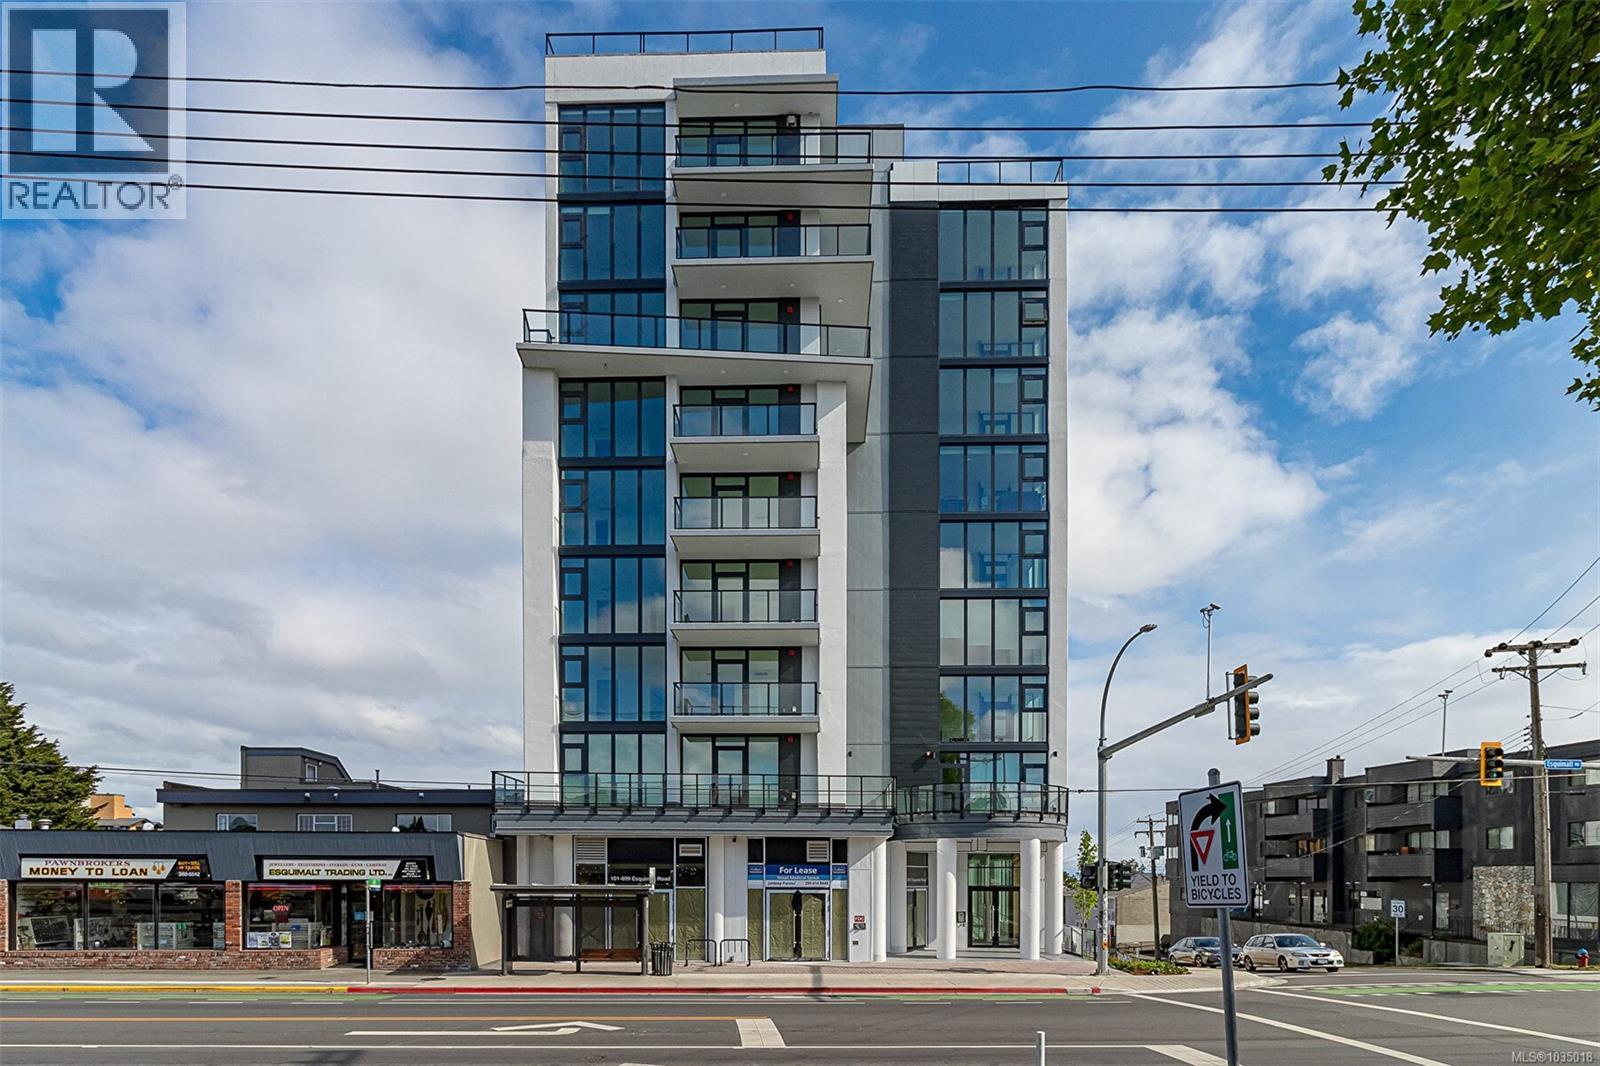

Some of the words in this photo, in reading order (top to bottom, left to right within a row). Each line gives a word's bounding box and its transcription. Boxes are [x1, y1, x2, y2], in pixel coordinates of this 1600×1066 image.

[44, 859, 131, 867] PAWNBROKERS
[29, 867, 78, 876] MONEY
[85, 867, 104, 876] TO
[112, 867, 148, 876] LOAN
[779, 866, 793, 874] For
[794, 866, 818, 875] Lease
[1191, 875, 1219, 886] YIELD
[1222, 873, 1236, 885] TO
[1192, 887, 1241, 900] BICYCLES
[272, 904, 289, 912] OPEN
[1392, 905, 1404, 913] 30
